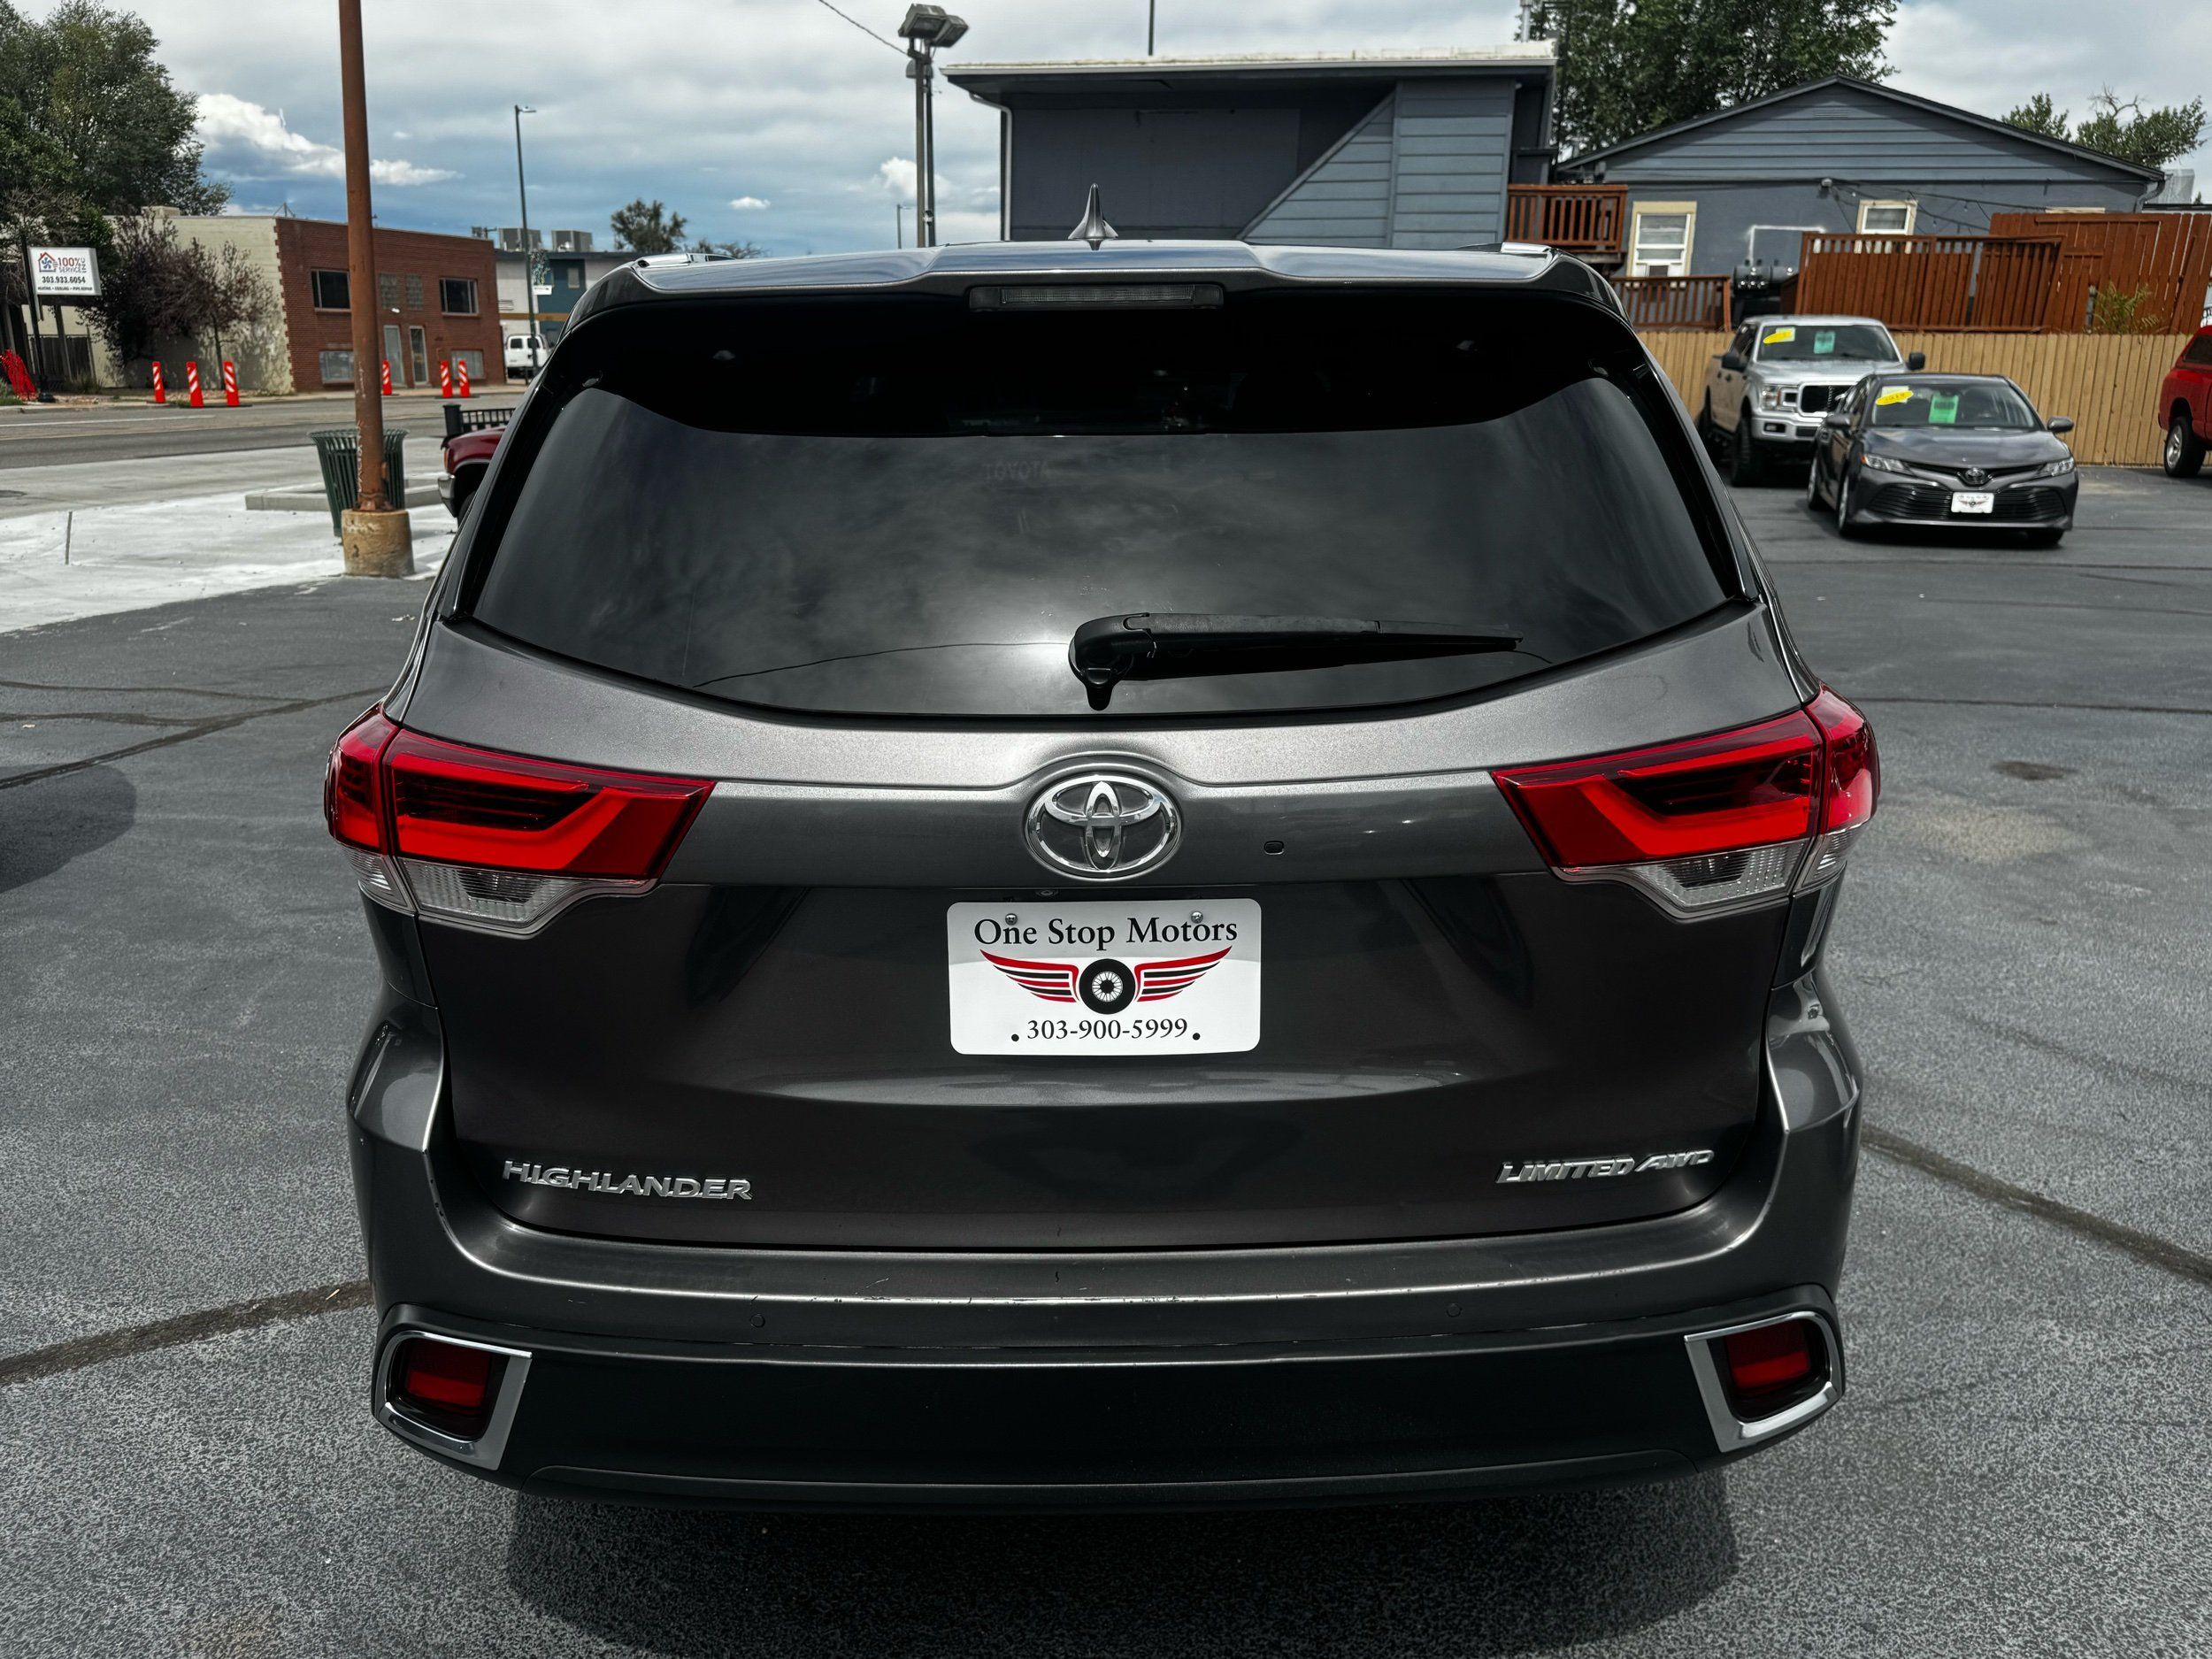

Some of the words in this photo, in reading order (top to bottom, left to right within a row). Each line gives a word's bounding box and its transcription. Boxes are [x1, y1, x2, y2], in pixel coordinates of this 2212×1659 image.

[58, 257, 81, 267] 100%
[981, 460, 1051, 481] TOYOTA
[974, 918, 1037, 945] One
[1048, 918, 1115, 951] Stop
[1126, 917, 1238, 944] Motors
[1027, 1018, 1188, 1041] 303-900-5999
[503, 1159, 753, 1201] HIGHLANDER
[1495, 1156, 1635, 1184] LIMITED
[1634, 1149, 1715, 1171] AWD
